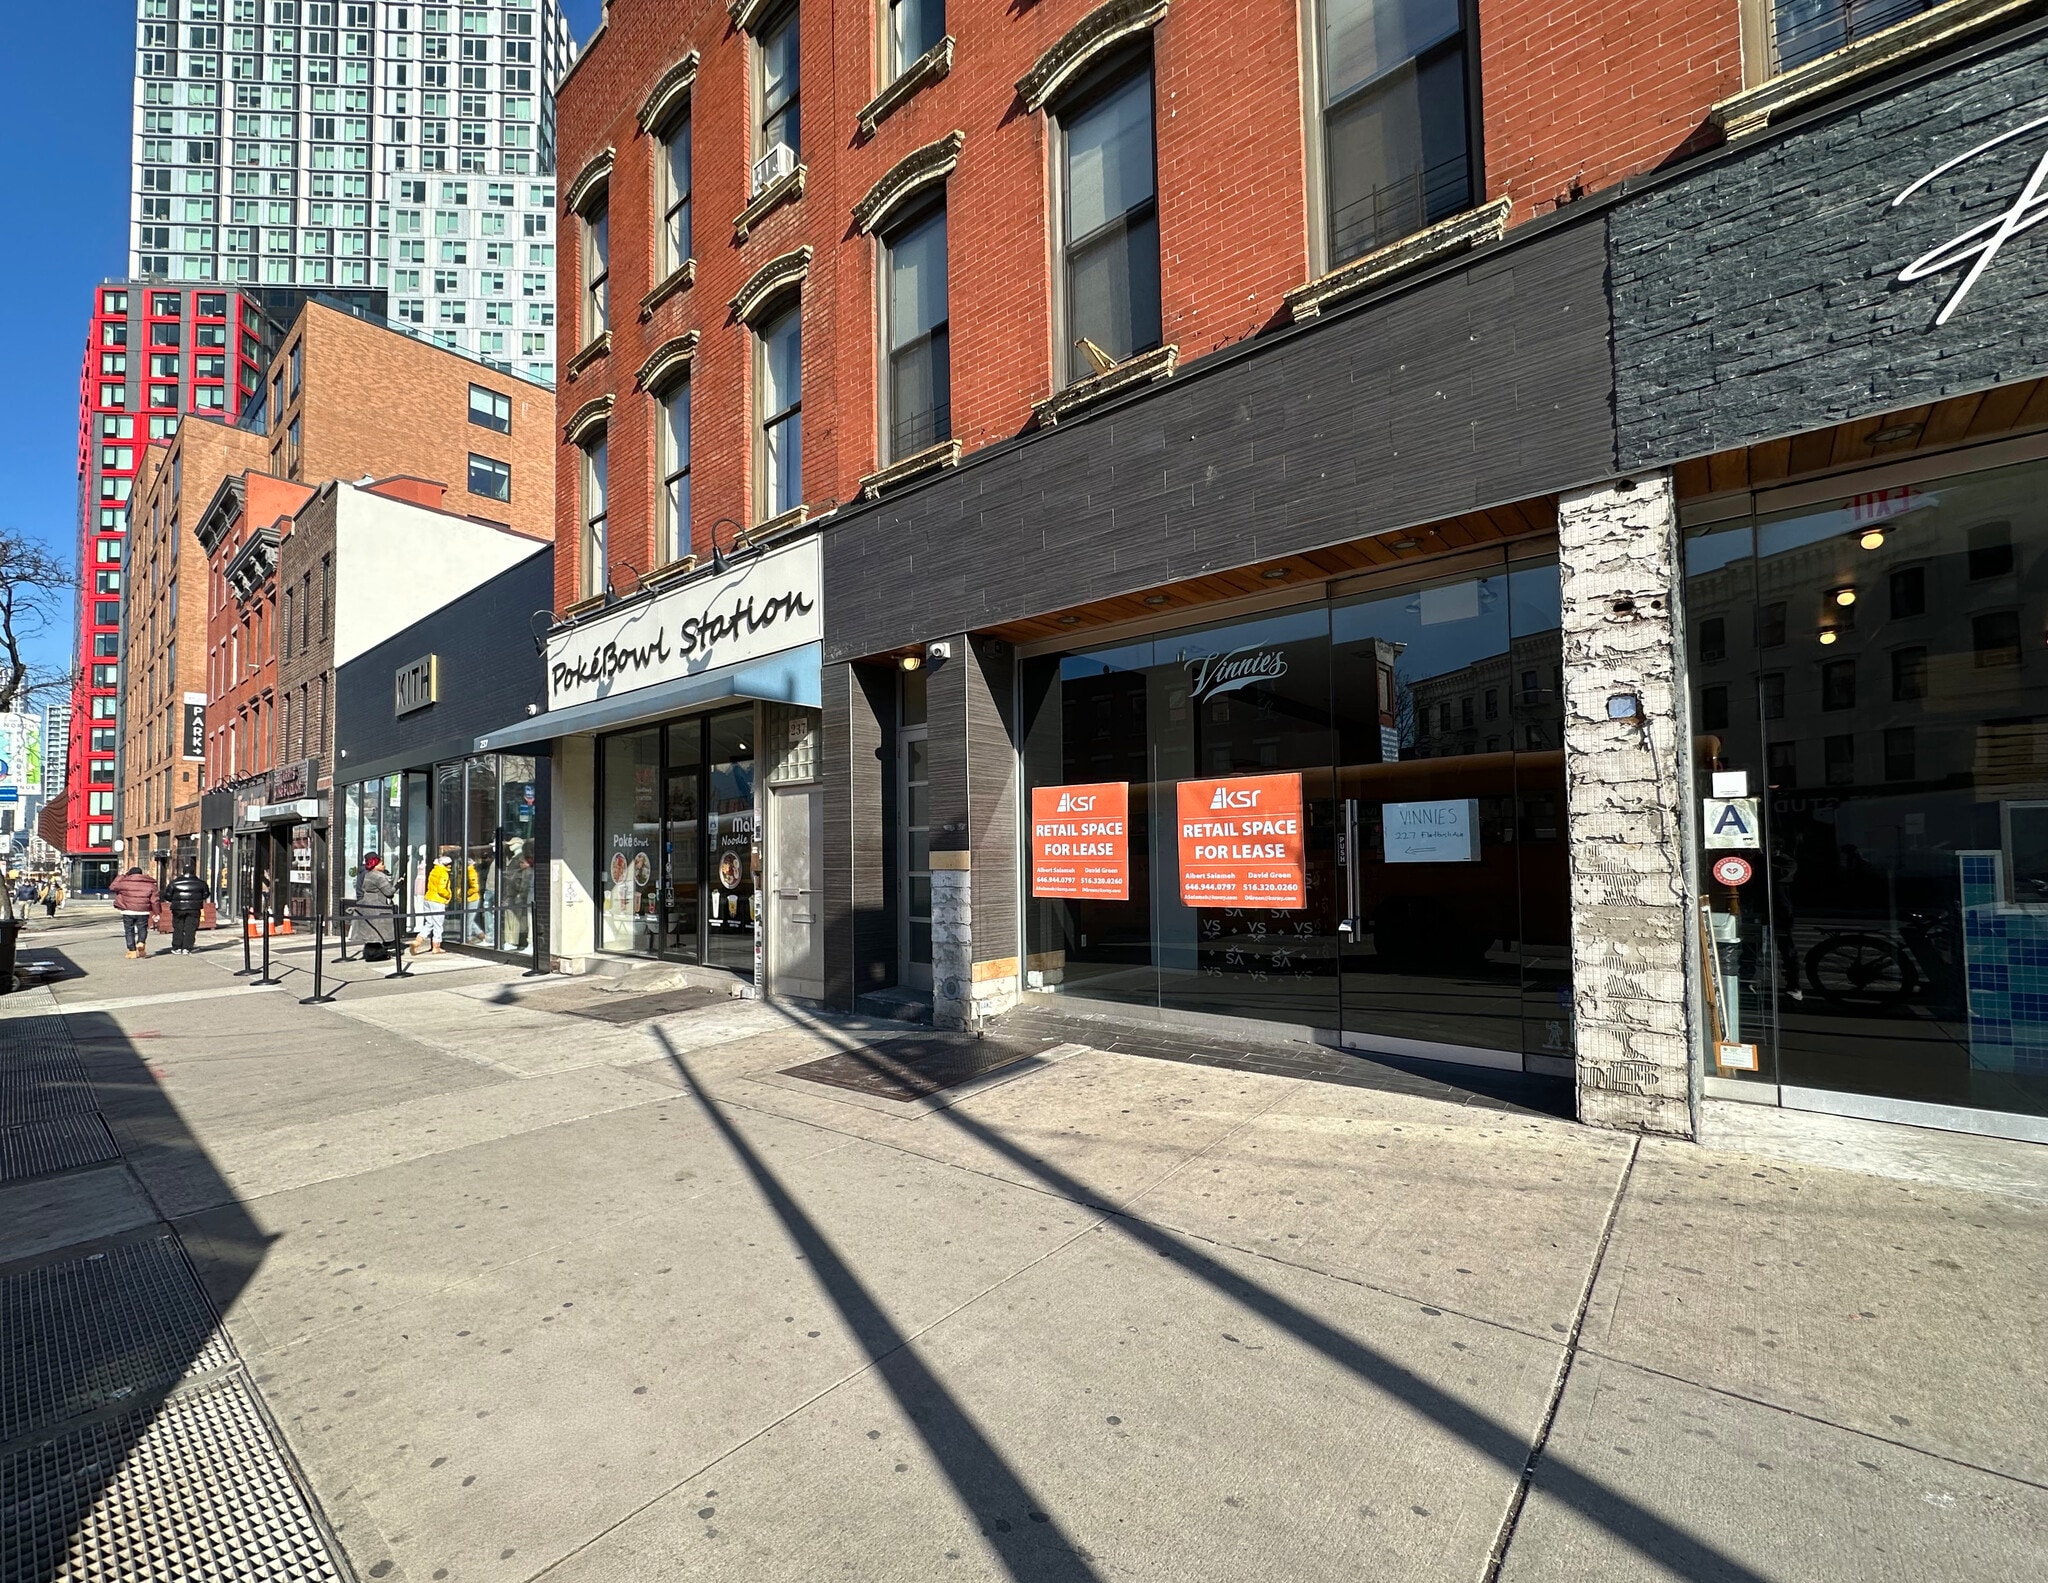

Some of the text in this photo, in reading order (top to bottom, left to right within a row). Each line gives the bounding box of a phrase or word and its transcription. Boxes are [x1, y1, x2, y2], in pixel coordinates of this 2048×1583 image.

[551, 591, 814, 697] PokéBowl Station
[1184, 637, 1288, 704] Vinnie's
[397, 662, 430, 708] KITH
[192, 706, 204, 747] PARK
[790, 723, 806, 736] 237
[1066, 793, 1096, 812] ksr
[1222, 787, 1261, 809] ksr
[1400, 808, 1458, 825] VINNIES
[1713, 805, 1749, 834] A
[1036, 822, 1123, 837] RETAIL SPACE
[1183, 820, 1297, 838] RETAIL SPACE
[1395, 831, 1416, 840] 227
[613, 834, 633, 847] Poké
[721, 834, 748, 846] Noodle
[1044, 843, 1114, 856] FOR LEASE
[1195, 843, 1286, 859] FOR LEASE
[1185, 883, 1236, 891] 646.944.0797
[1242, 883, 1298, 891] 516.320.0260
[1203, 920, 1221, 931] VS
[1247, 922, 1267, 934] VS
[1294, 922, 1313, 934] VS
